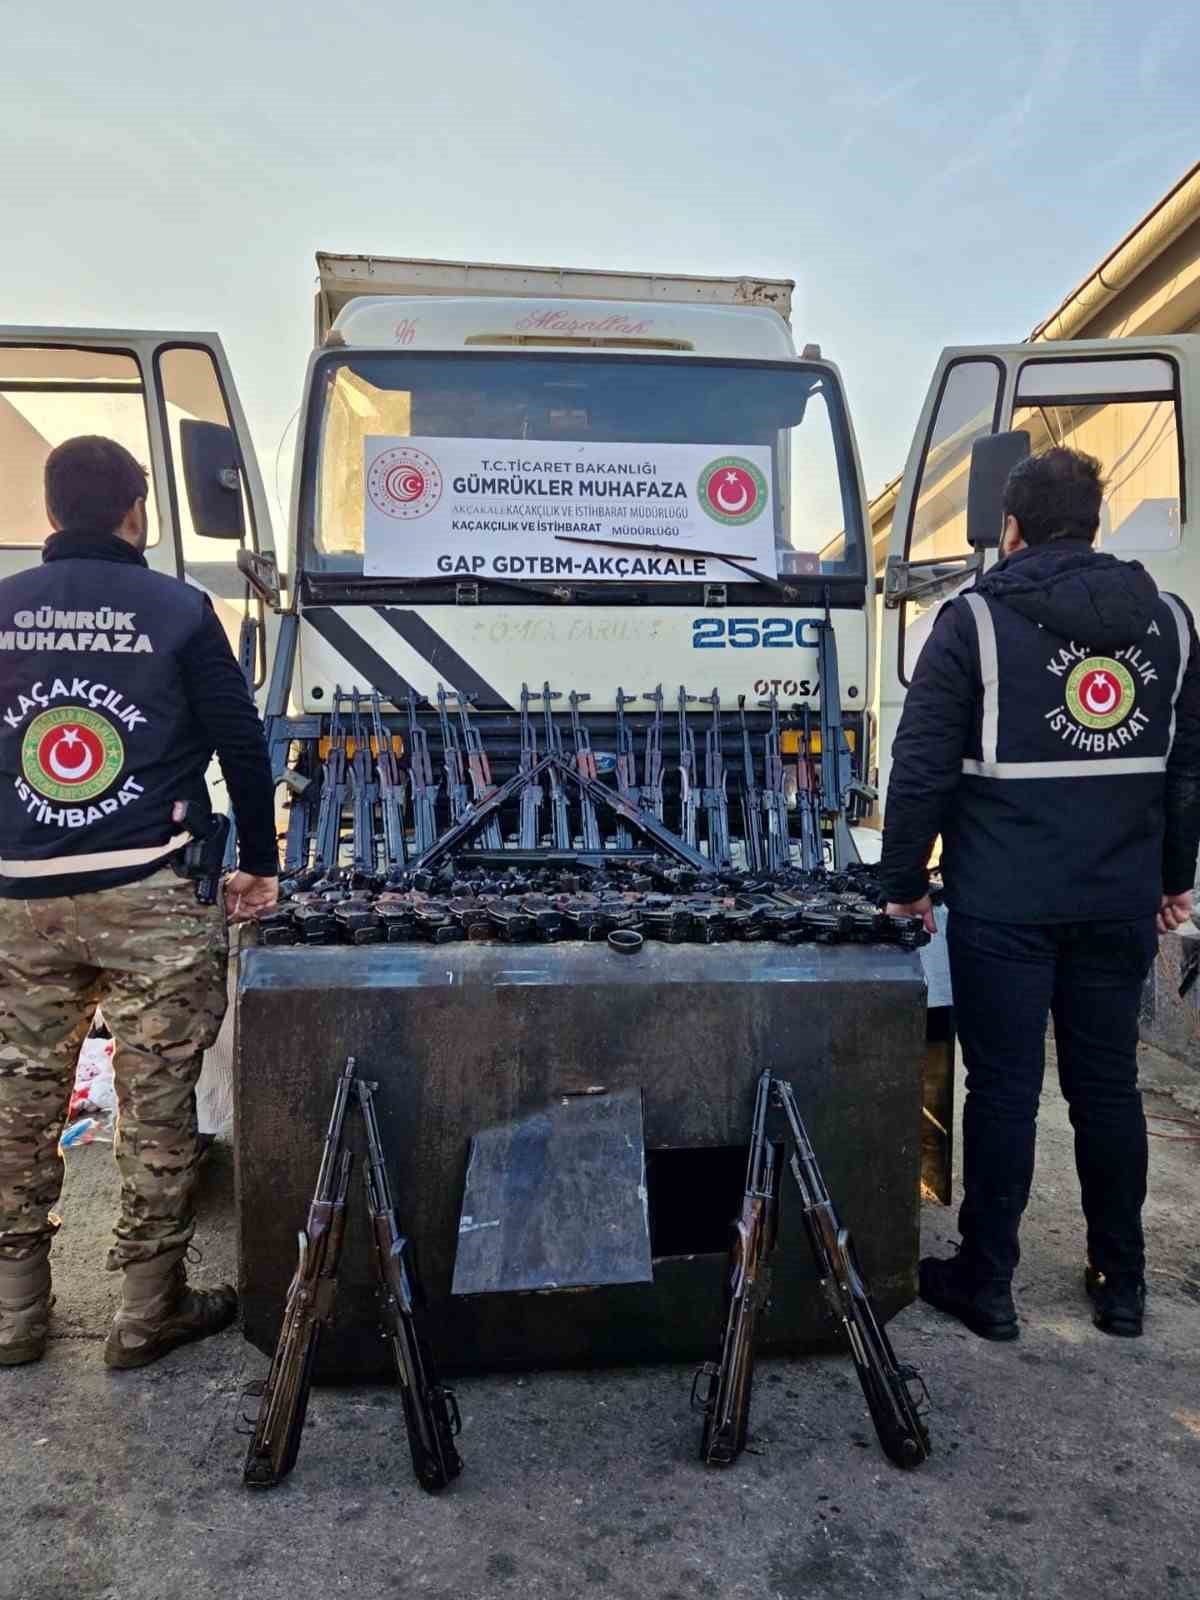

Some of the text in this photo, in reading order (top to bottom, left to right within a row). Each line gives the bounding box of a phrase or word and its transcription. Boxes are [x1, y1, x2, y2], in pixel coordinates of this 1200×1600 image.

[575, 461, 657, 475] BAKANLIĞI
[453, 473, 688, 498] GÜMRÜKLER MUHAFAZA
[561, 506, 572, 517] VE
[452, 520, 519, 532] KAÇAKÇILIK
[521, 522, 535, 531] VE
[537, 520, 602, 533] İSTİHBARAT
[437, 555, 707, 578] GAP GDTBM-AKÇAKALE
[14, 606, 136, 631] GÜMRÜK
[0, 631, 153, 652] MUHAFAZA
[3, 678, 148, 732] KAÇAKÇILIK
[1044, 705, 1150, 752] İSTİHBARAT
[14, 776, 144, 827] İSTİHBARAT
